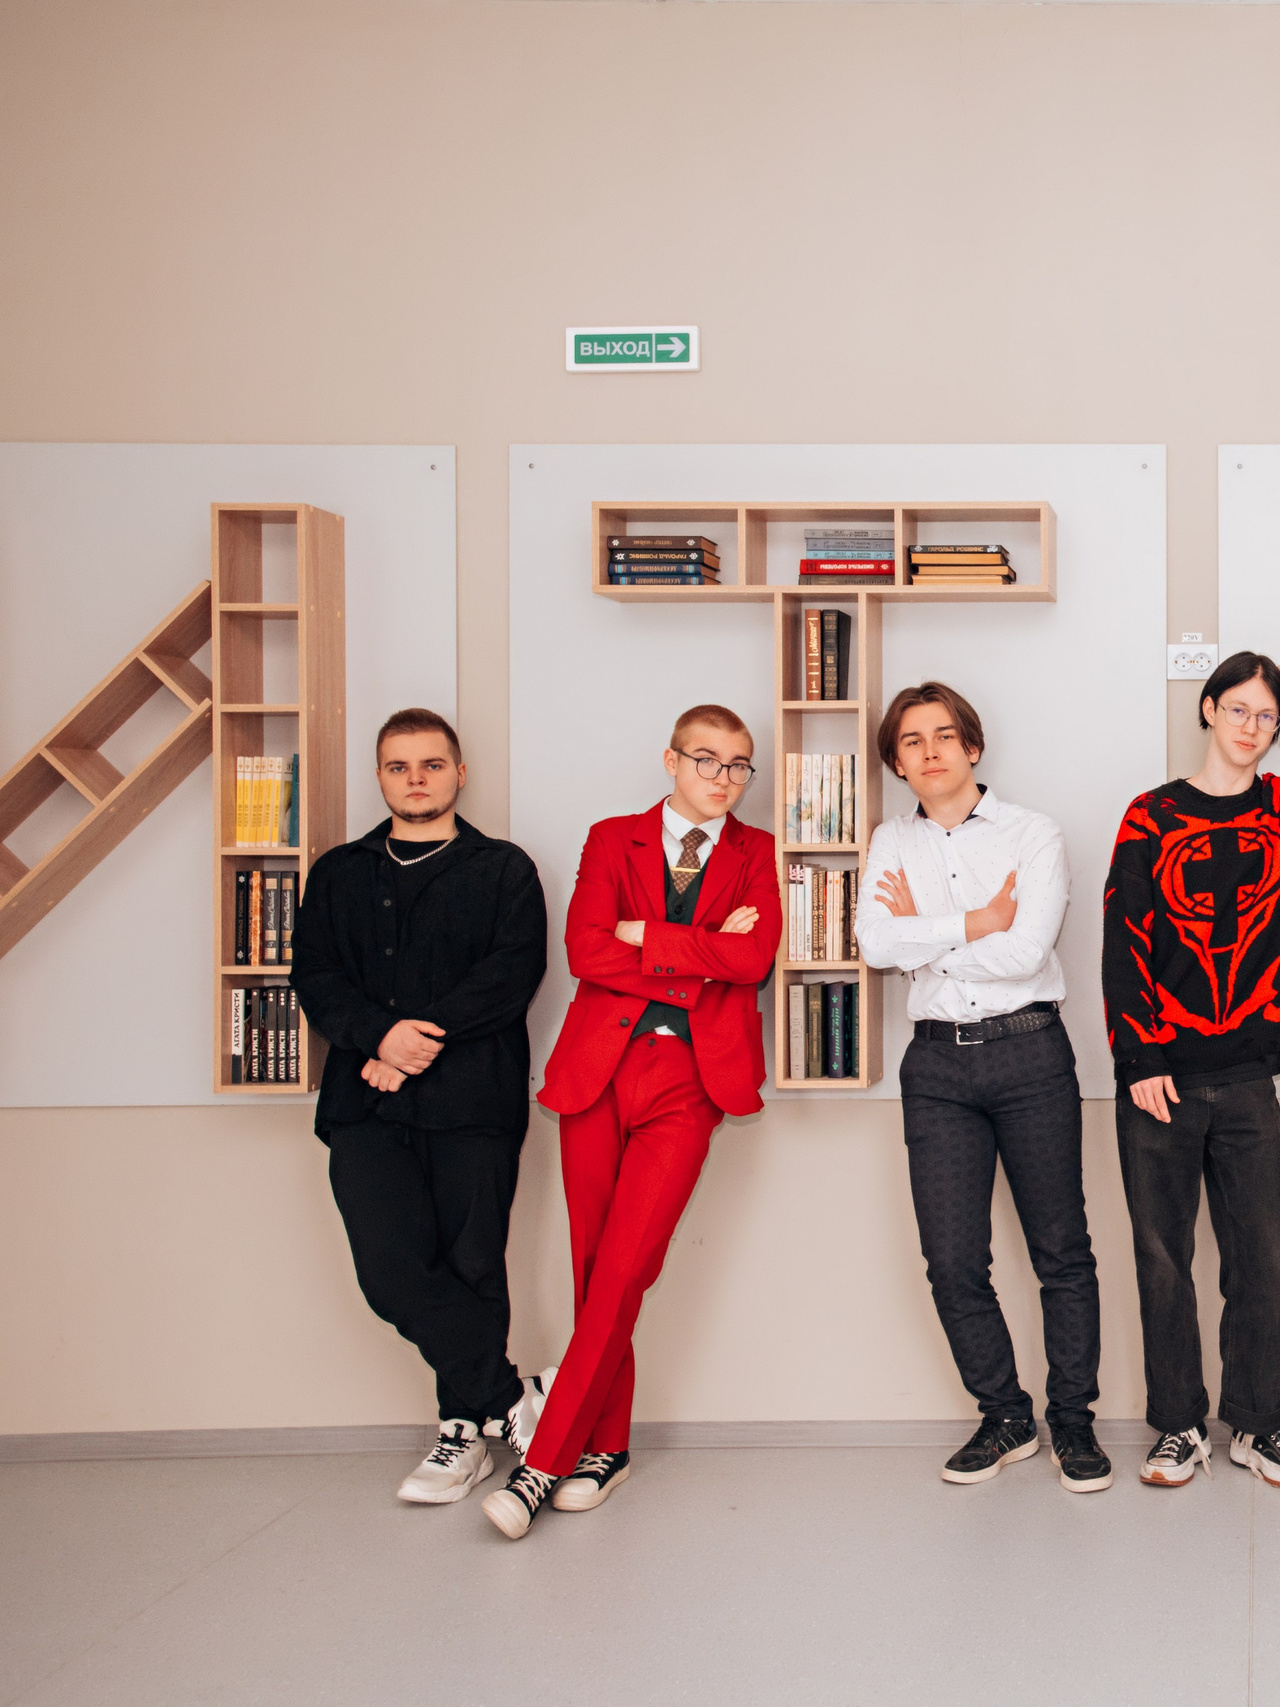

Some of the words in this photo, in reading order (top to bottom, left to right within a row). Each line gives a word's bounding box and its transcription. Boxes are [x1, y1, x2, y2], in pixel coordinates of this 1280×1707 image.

[580, 341, 650, 357] ВЫХОД
[813, 951, 818, 959] 3
[819, 950, 824, 958] 4
[850, 947, 857, 956] 2
